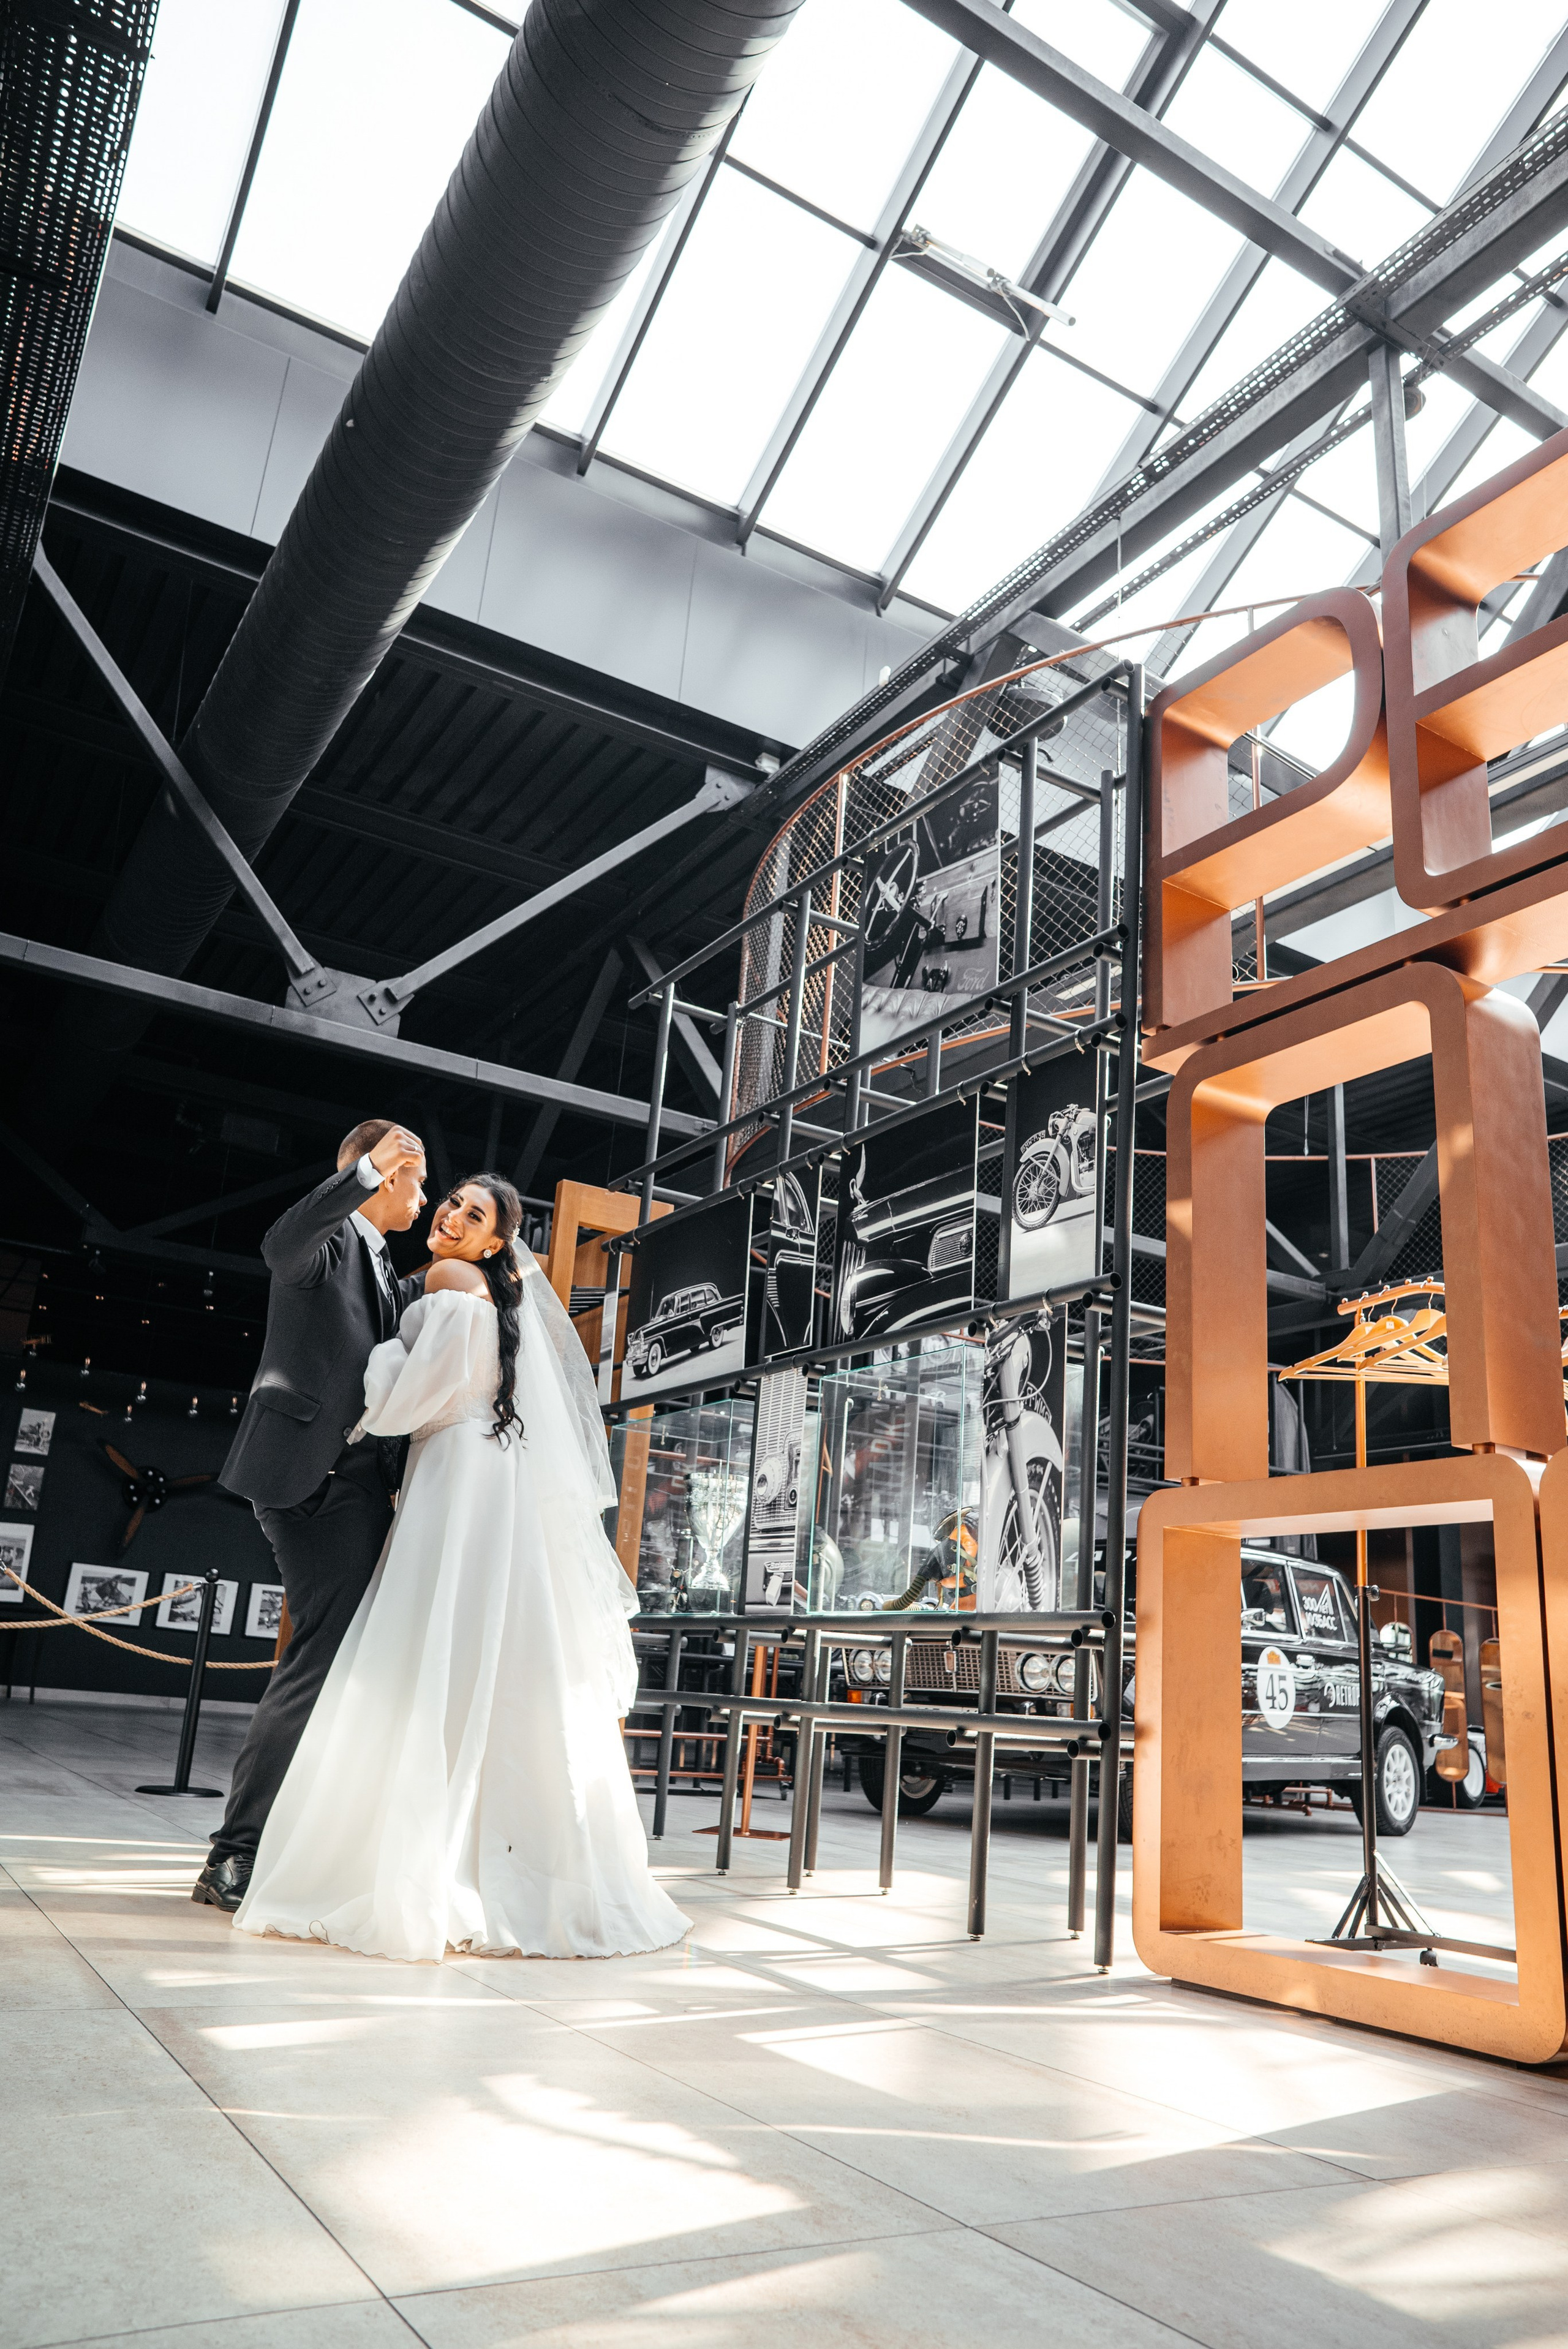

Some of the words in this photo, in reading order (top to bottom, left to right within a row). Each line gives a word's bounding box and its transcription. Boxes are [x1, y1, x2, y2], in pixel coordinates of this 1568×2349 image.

[957, 967, 990, 991] Ford
[1302, 1596, 1318, 1612] 300
[1265, 1673, 1288, 1710] 45
